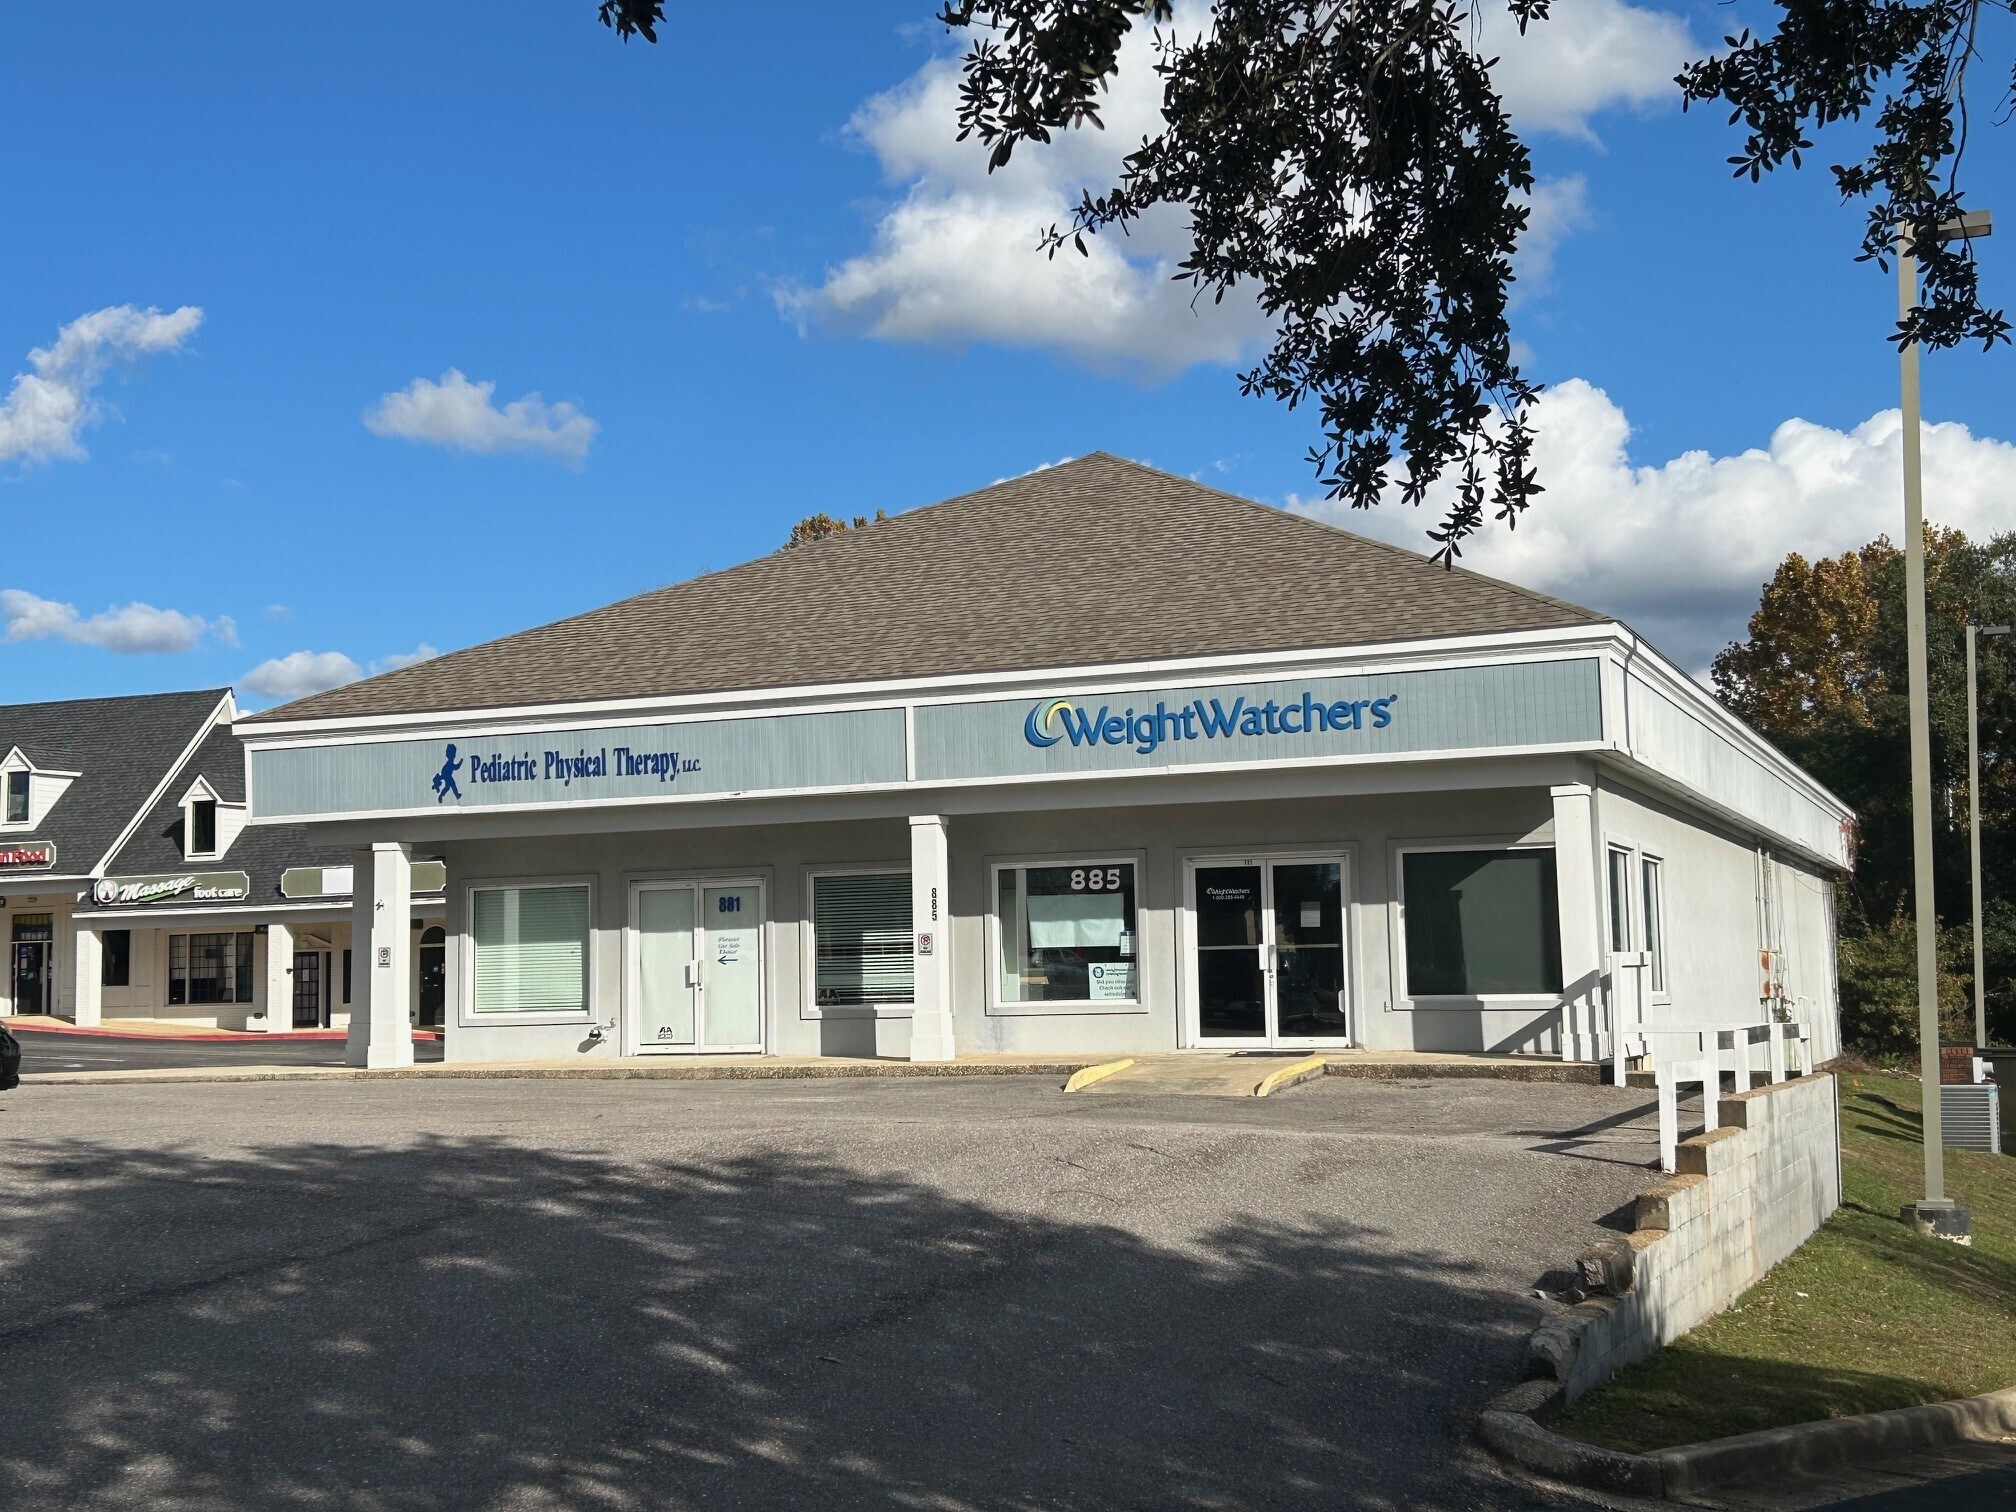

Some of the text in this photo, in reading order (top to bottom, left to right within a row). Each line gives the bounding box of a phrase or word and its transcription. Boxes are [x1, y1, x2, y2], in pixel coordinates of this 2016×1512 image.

[470, 752, 537, 784] Pediatric
[544, 748, 607, 786] Physical
[613, 747, 680, 783] Therapy,
[13, 848, 49, 863] Food
[119, 876, 196, 901] Massage
[1070, 869, 1120, 890] 885
[193, 887, 243, 899] foot care
[718, 896, 740, 912] 881
